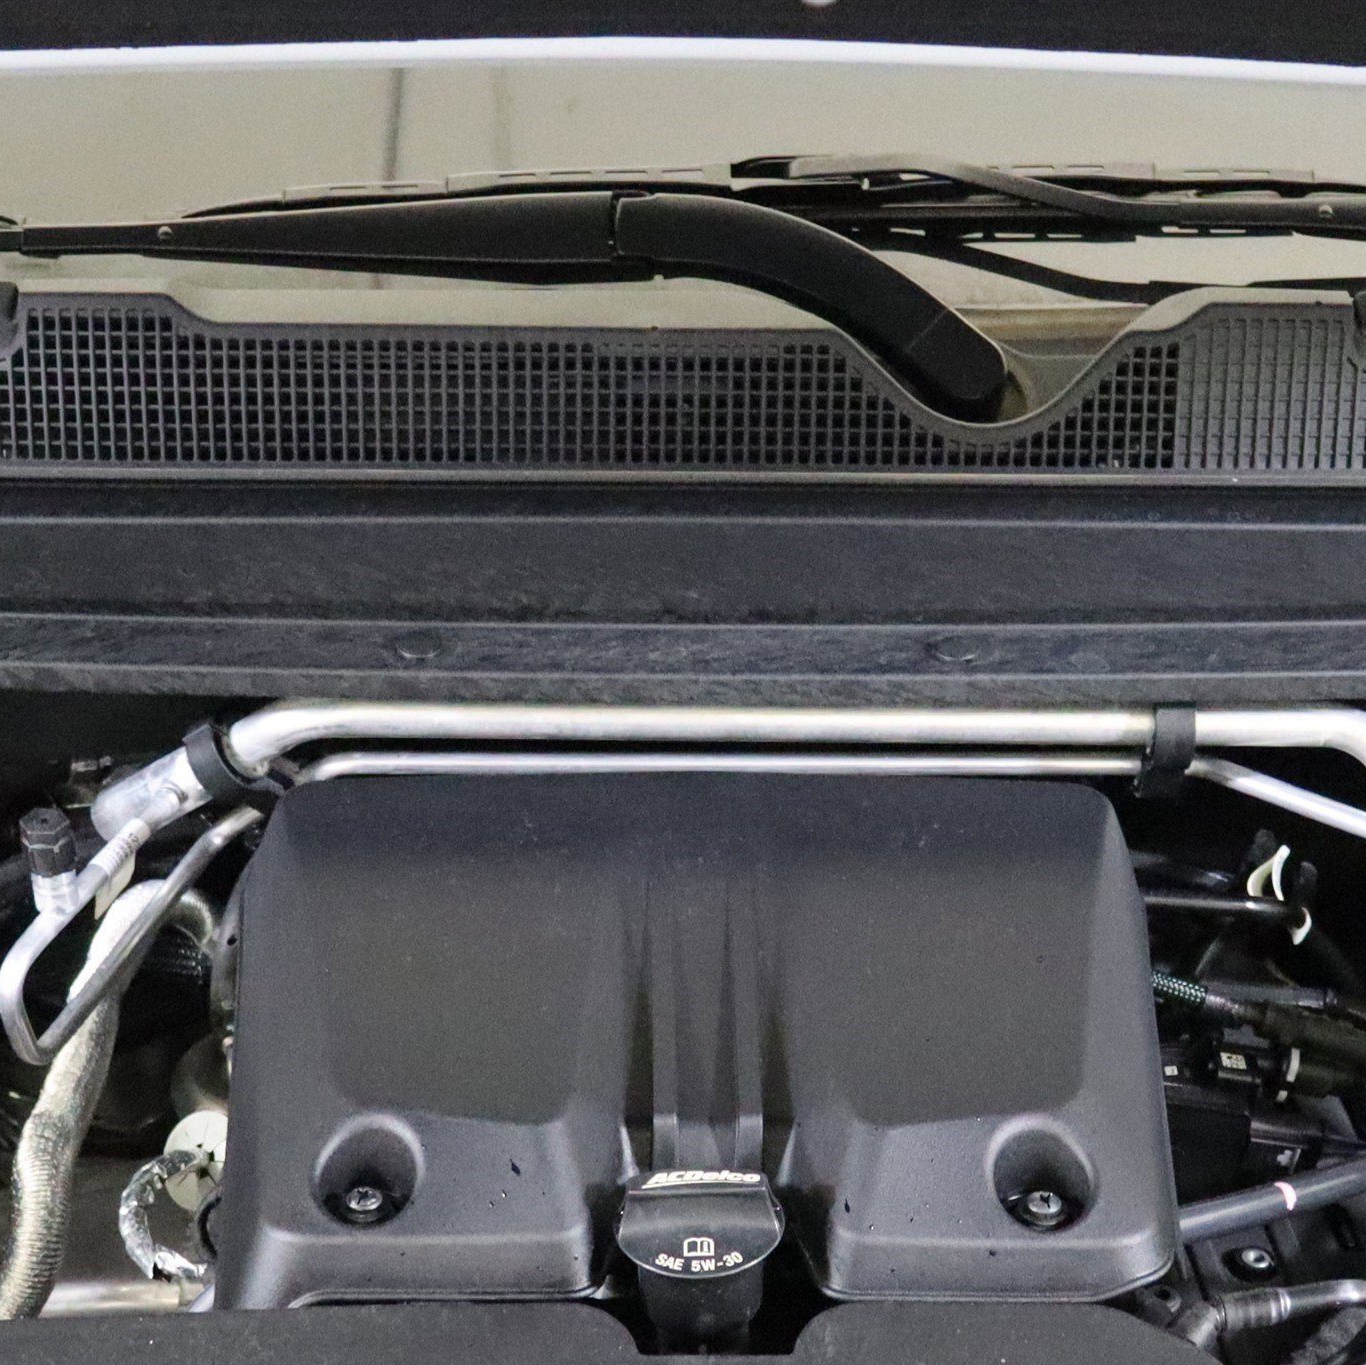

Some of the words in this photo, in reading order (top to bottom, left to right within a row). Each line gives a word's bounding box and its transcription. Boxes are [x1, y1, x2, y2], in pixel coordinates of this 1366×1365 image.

[646, 1170, 762, 1187] ACDelco
[655, 1252, 685, 1271] SAE
[691, 1252, 743, 1272] 5W-30
